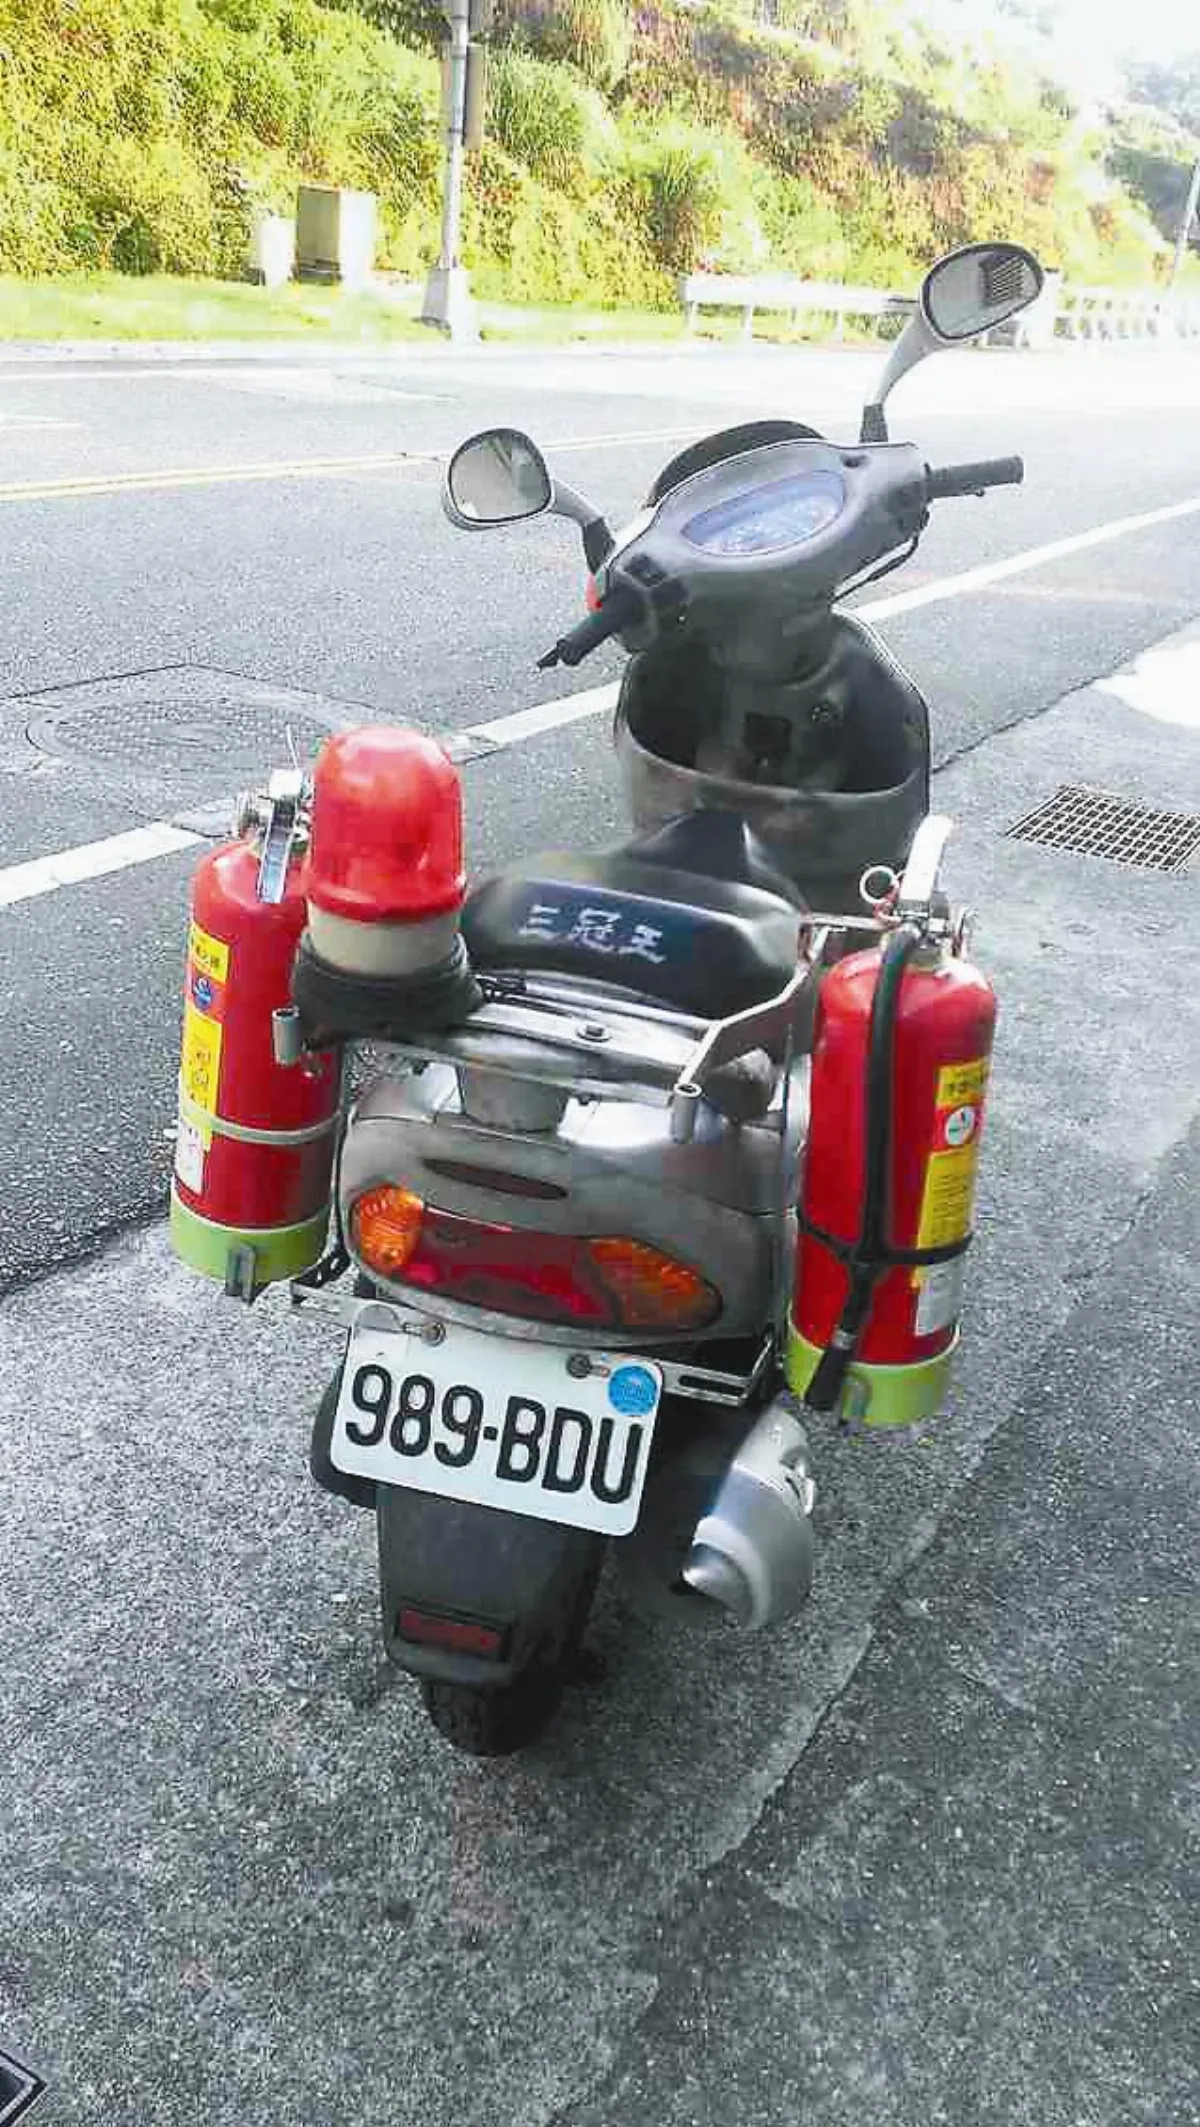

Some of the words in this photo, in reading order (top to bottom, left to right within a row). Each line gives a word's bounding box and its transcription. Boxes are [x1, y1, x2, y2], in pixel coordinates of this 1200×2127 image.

[518, 904, 666, 963] 三冠王
[345, 1363, 643, 1504] 989-BDU
